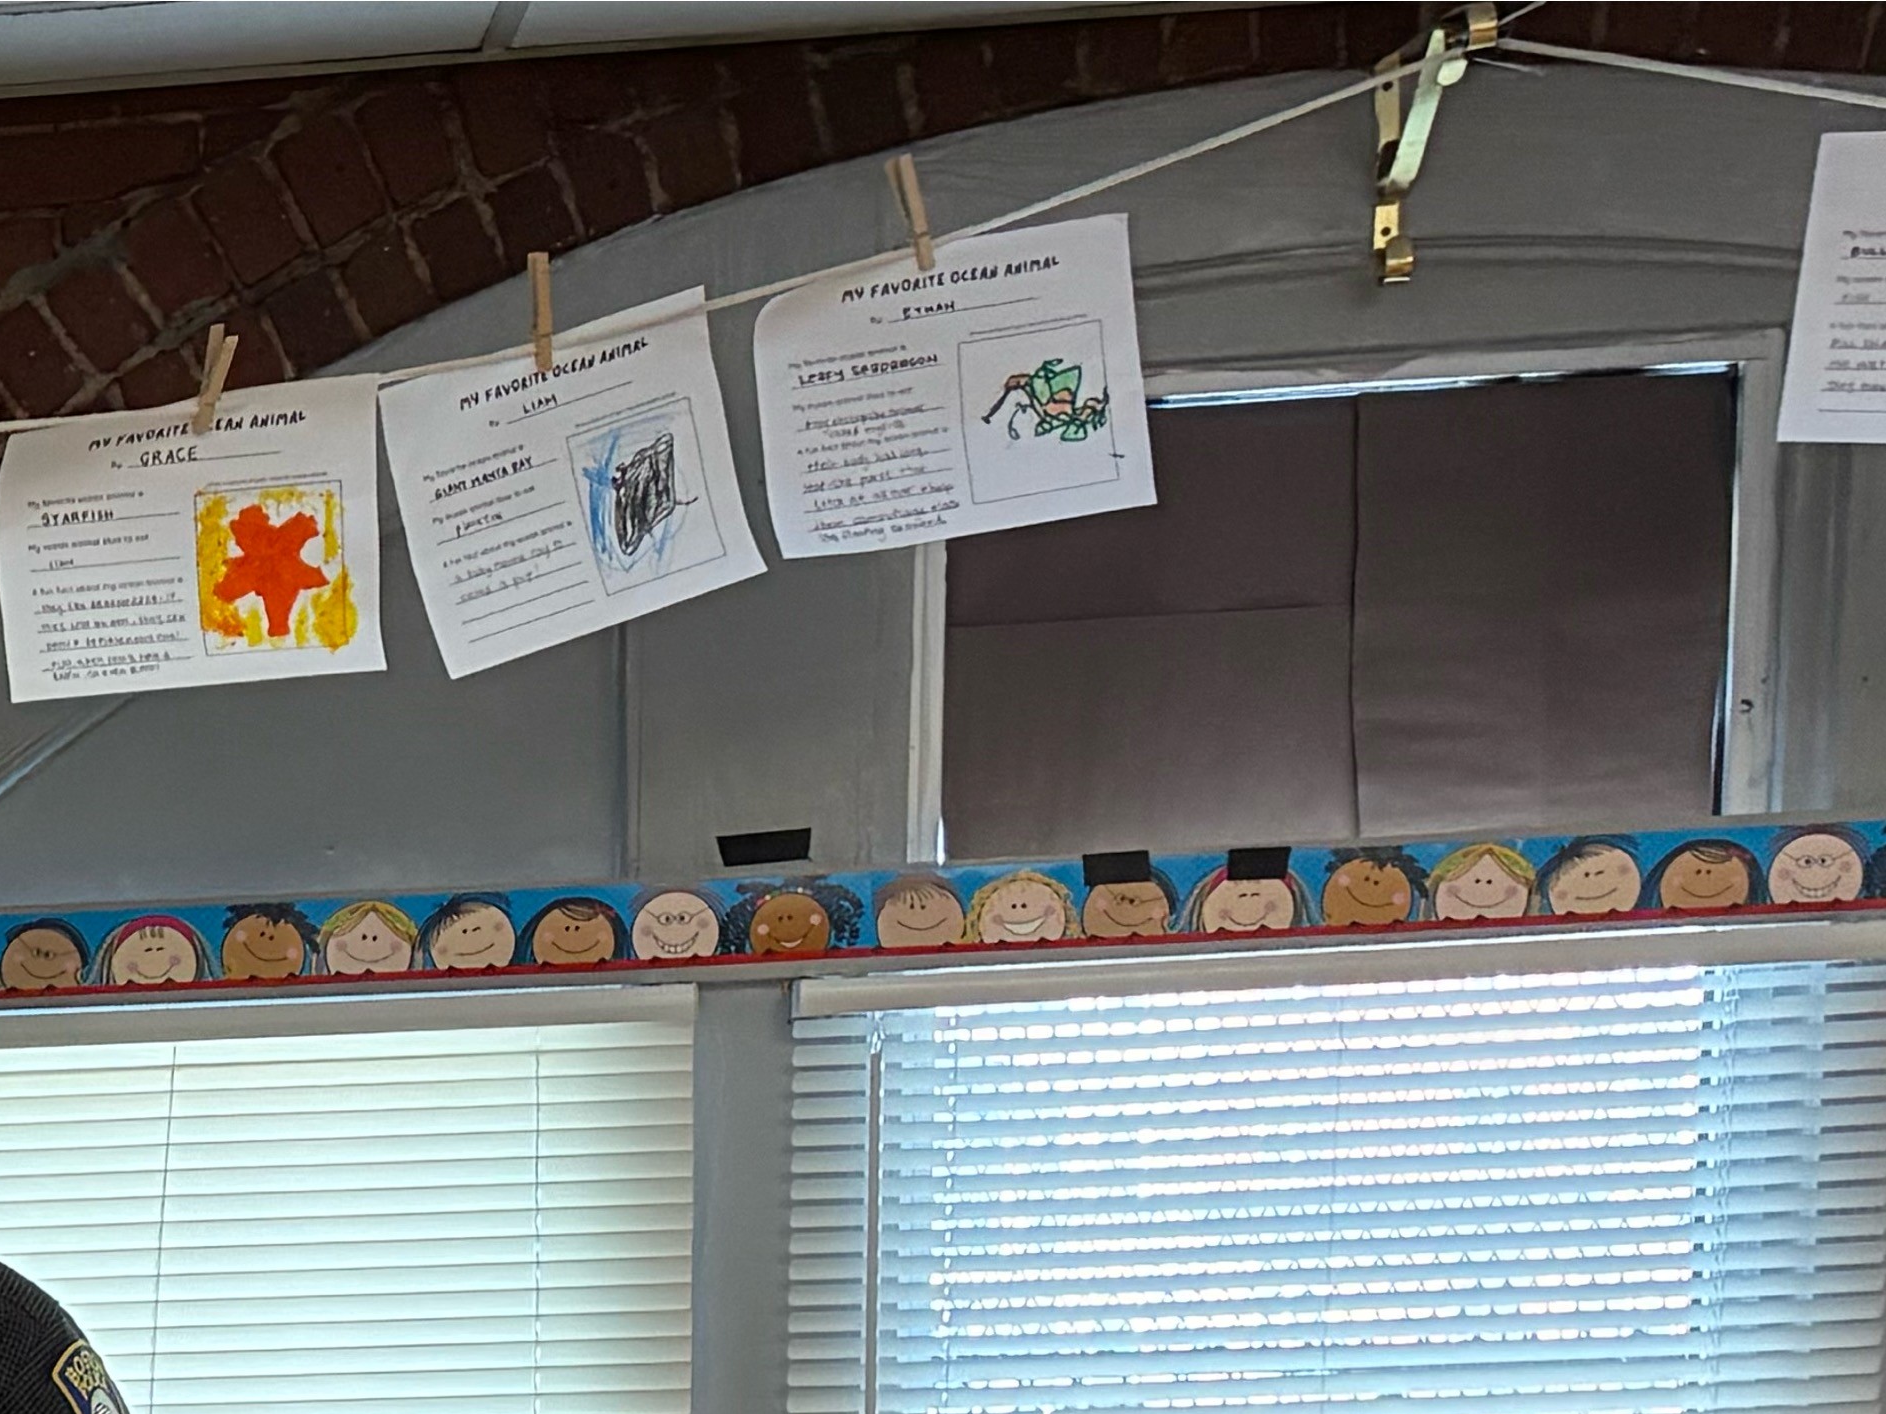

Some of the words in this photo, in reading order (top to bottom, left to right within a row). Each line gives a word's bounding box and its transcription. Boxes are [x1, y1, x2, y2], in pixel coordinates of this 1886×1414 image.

[842, 288, 864, 303] MY
[871, 273, 944, 298] FAVORITE
[950, 265, 998, 286] OCEAN
[1004, 256, 1060, 278] ANIMAL
[459, 394, 479, 410] MY
[485, 369, 549, 401] FAVORITE
[552, 355, 595, 378] OCEAN
[599, 337, 648, 363] ANIMAL
[523, 394, 558, 415] LIAM
[89, 437, 111, 452] MY
[116, 422, 190, 446] FAVORITE
[249, 411, 306, 428] ANIMAL
[140, 447, 198, 467] GRACE
